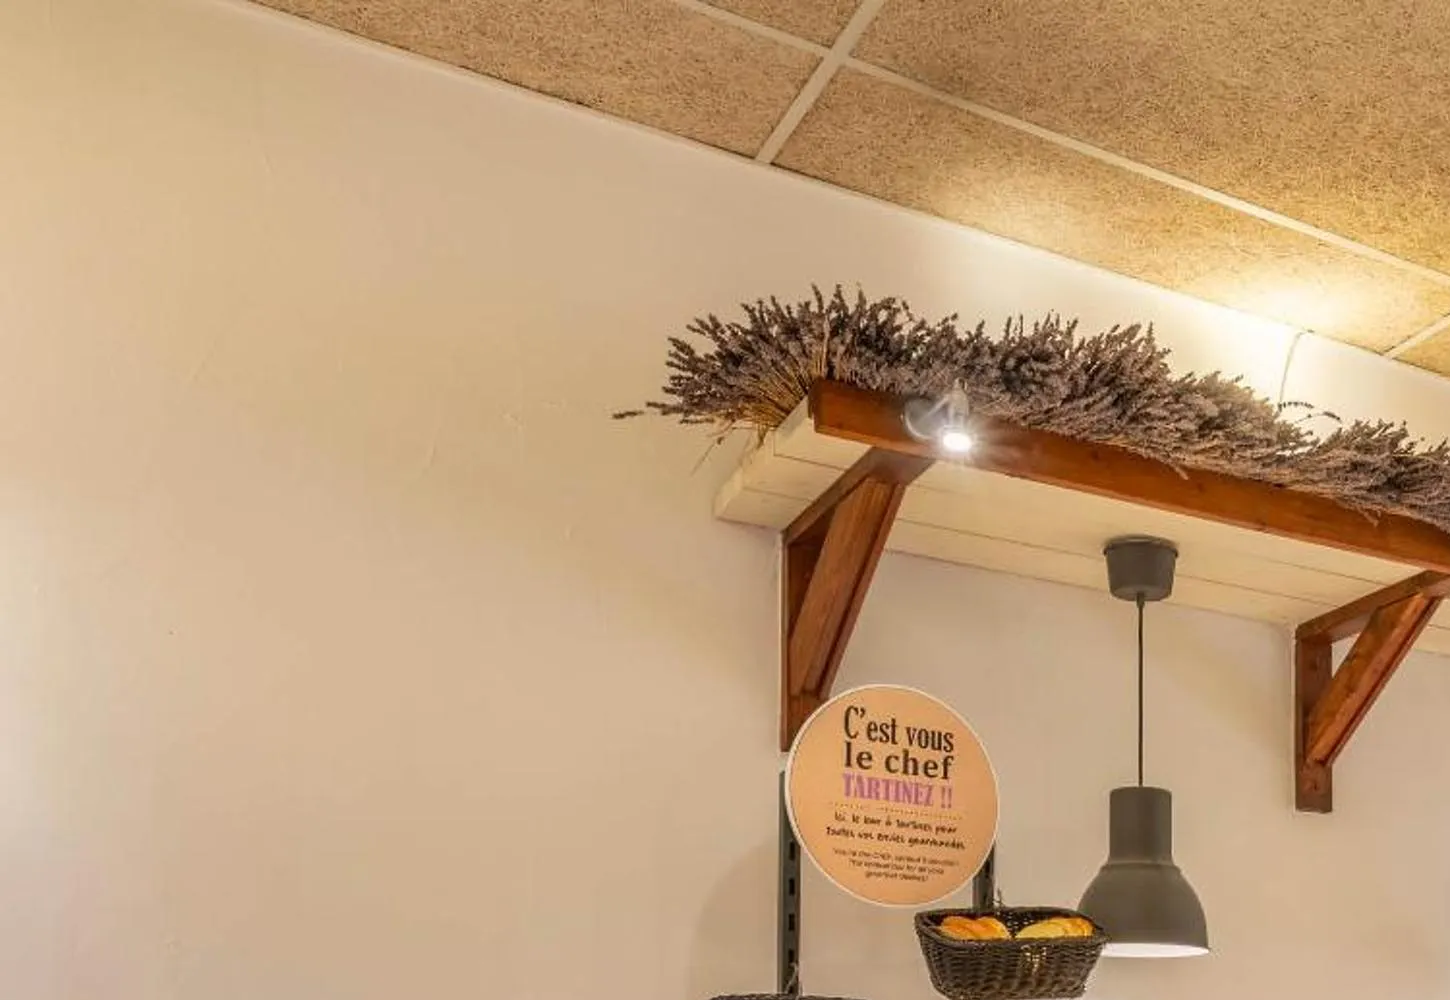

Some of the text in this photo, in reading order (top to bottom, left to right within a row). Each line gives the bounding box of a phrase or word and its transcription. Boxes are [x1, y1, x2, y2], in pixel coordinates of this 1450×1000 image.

[843, 705, 955, 753] C'est vous
[845, 741, 955, 780] le chef
[843, 772, 952, 809] TARTINEZ !!
